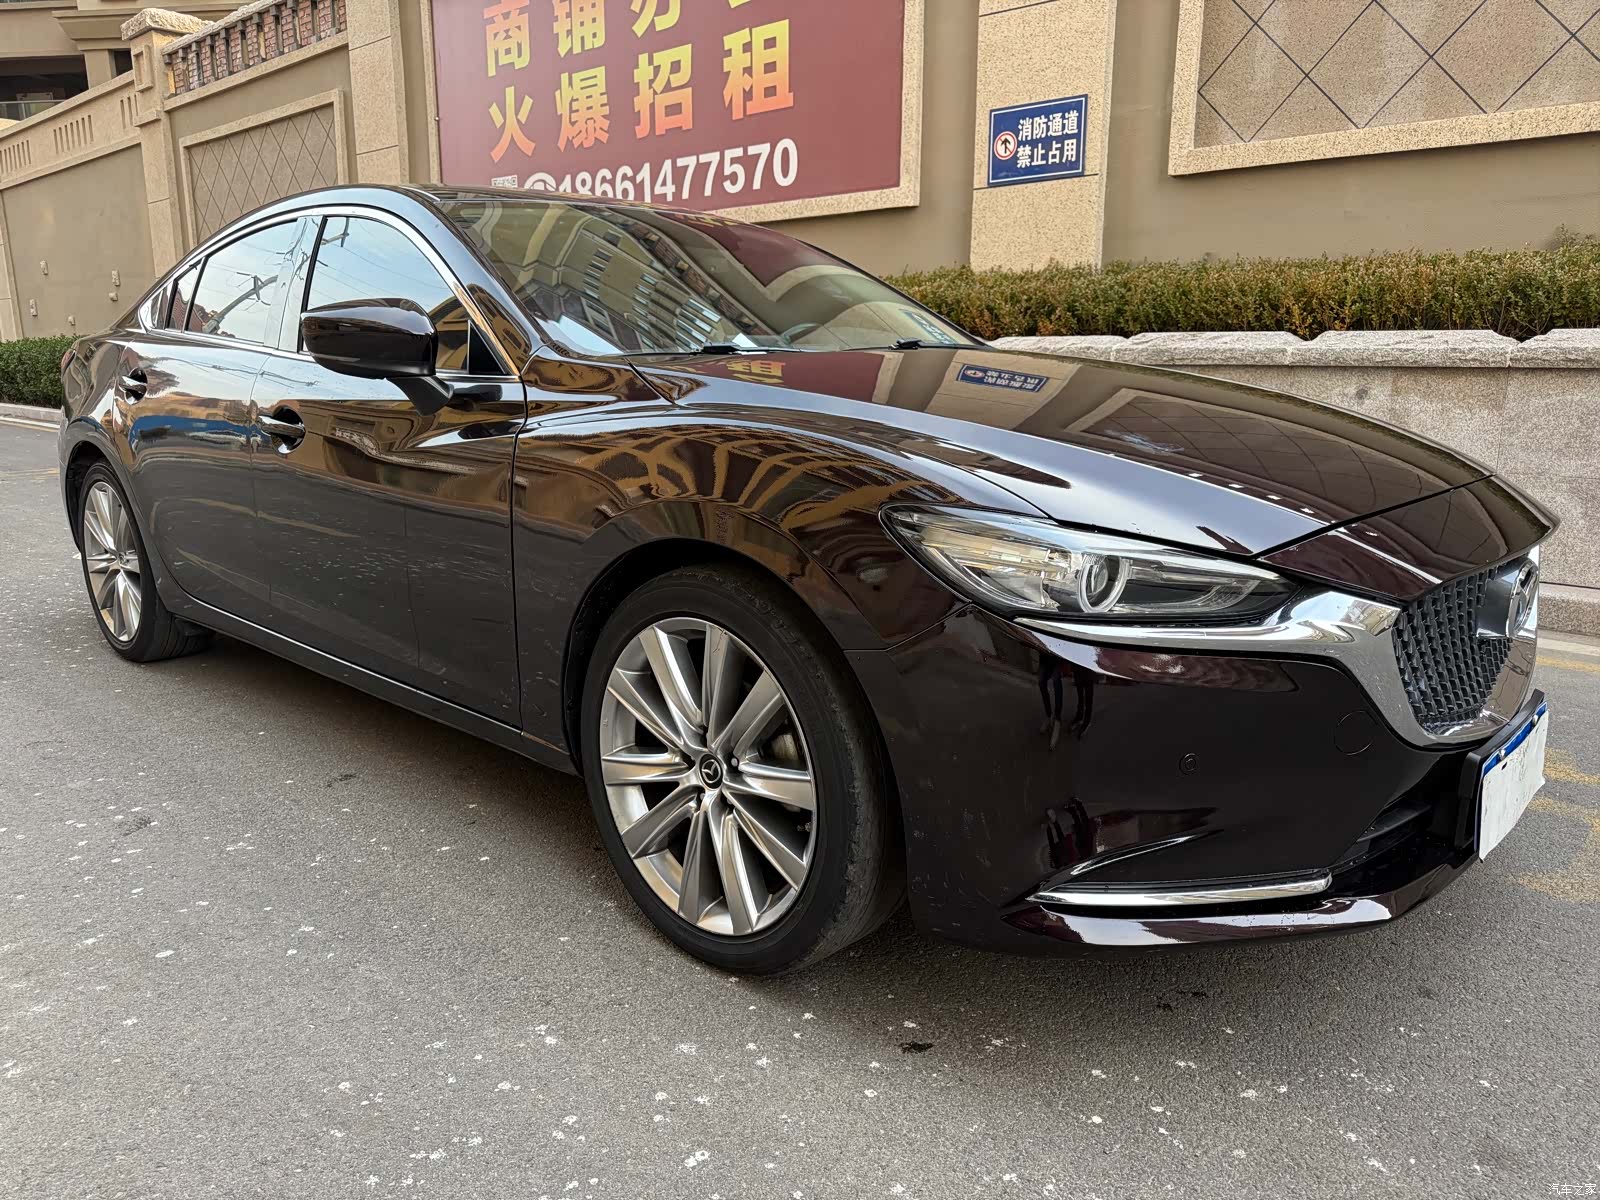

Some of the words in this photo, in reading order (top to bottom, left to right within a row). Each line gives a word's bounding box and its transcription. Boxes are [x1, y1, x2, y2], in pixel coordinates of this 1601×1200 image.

[484, 0, 750, 77] 商铺
[488, 19, 794, 163] 火爆招租
[1017, 139, 1077, 168] 禁止占用
[1018, 110, 1079, 141] 消防通道
[559, 138, 798, 203] 18661477570
